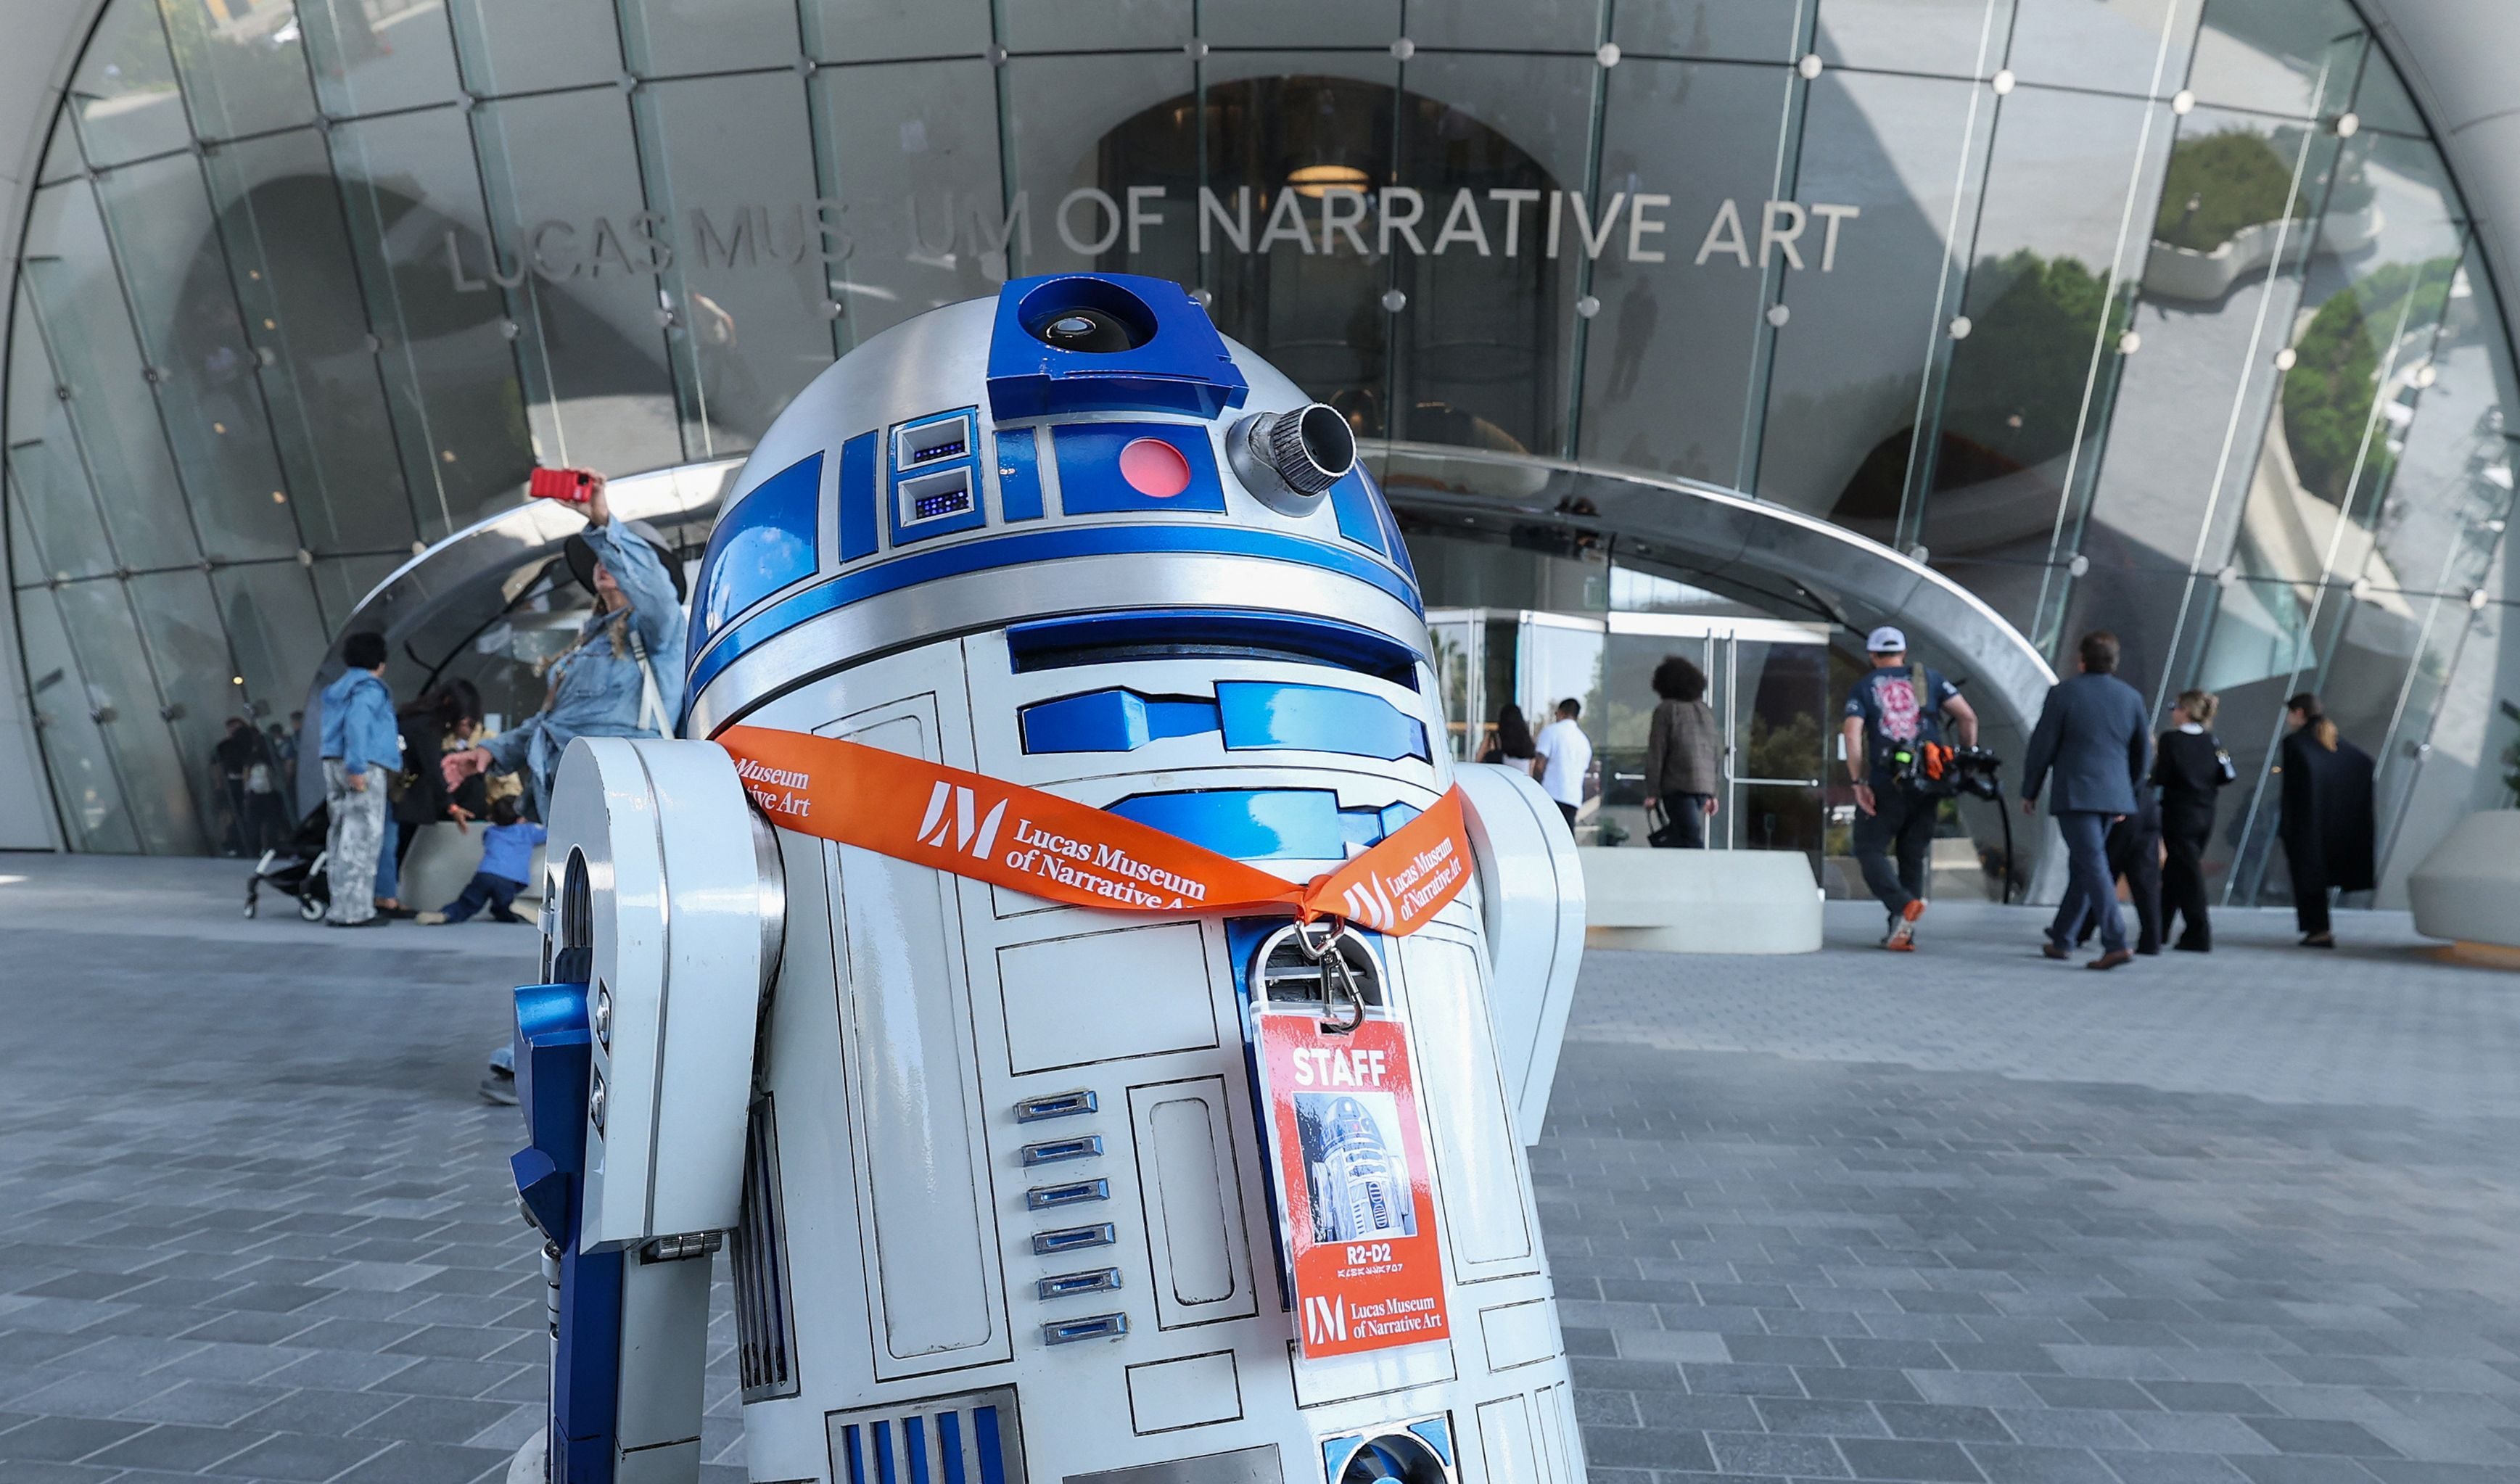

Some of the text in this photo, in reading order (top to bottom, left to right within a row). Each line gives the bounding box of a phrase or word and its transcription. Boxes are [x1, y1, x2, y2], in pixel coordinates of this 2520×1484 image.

[445, 185, 1861, 292] LUCAS MUSUM OF NARRATIVE ART
[736, 757, 810, 790] Museum
[775, 791, 812, 817] Art
[1005, 849, 1164, 909] of Narrative
[1013, 818, 1206, 902] Lucas Museum
[1385, 836, 1454, 898] Lucas Museum
[1400, 854, 1462, 922] of Narrative Art
[1293, 1047, 1387, 1087] STAFF
[1346, 1242, 1392, 1266] R2-D2
[1350, 1296, 1436, 1321] Lucas Museum
[1353, 1312, 1443, 1340] of Narrative Art
